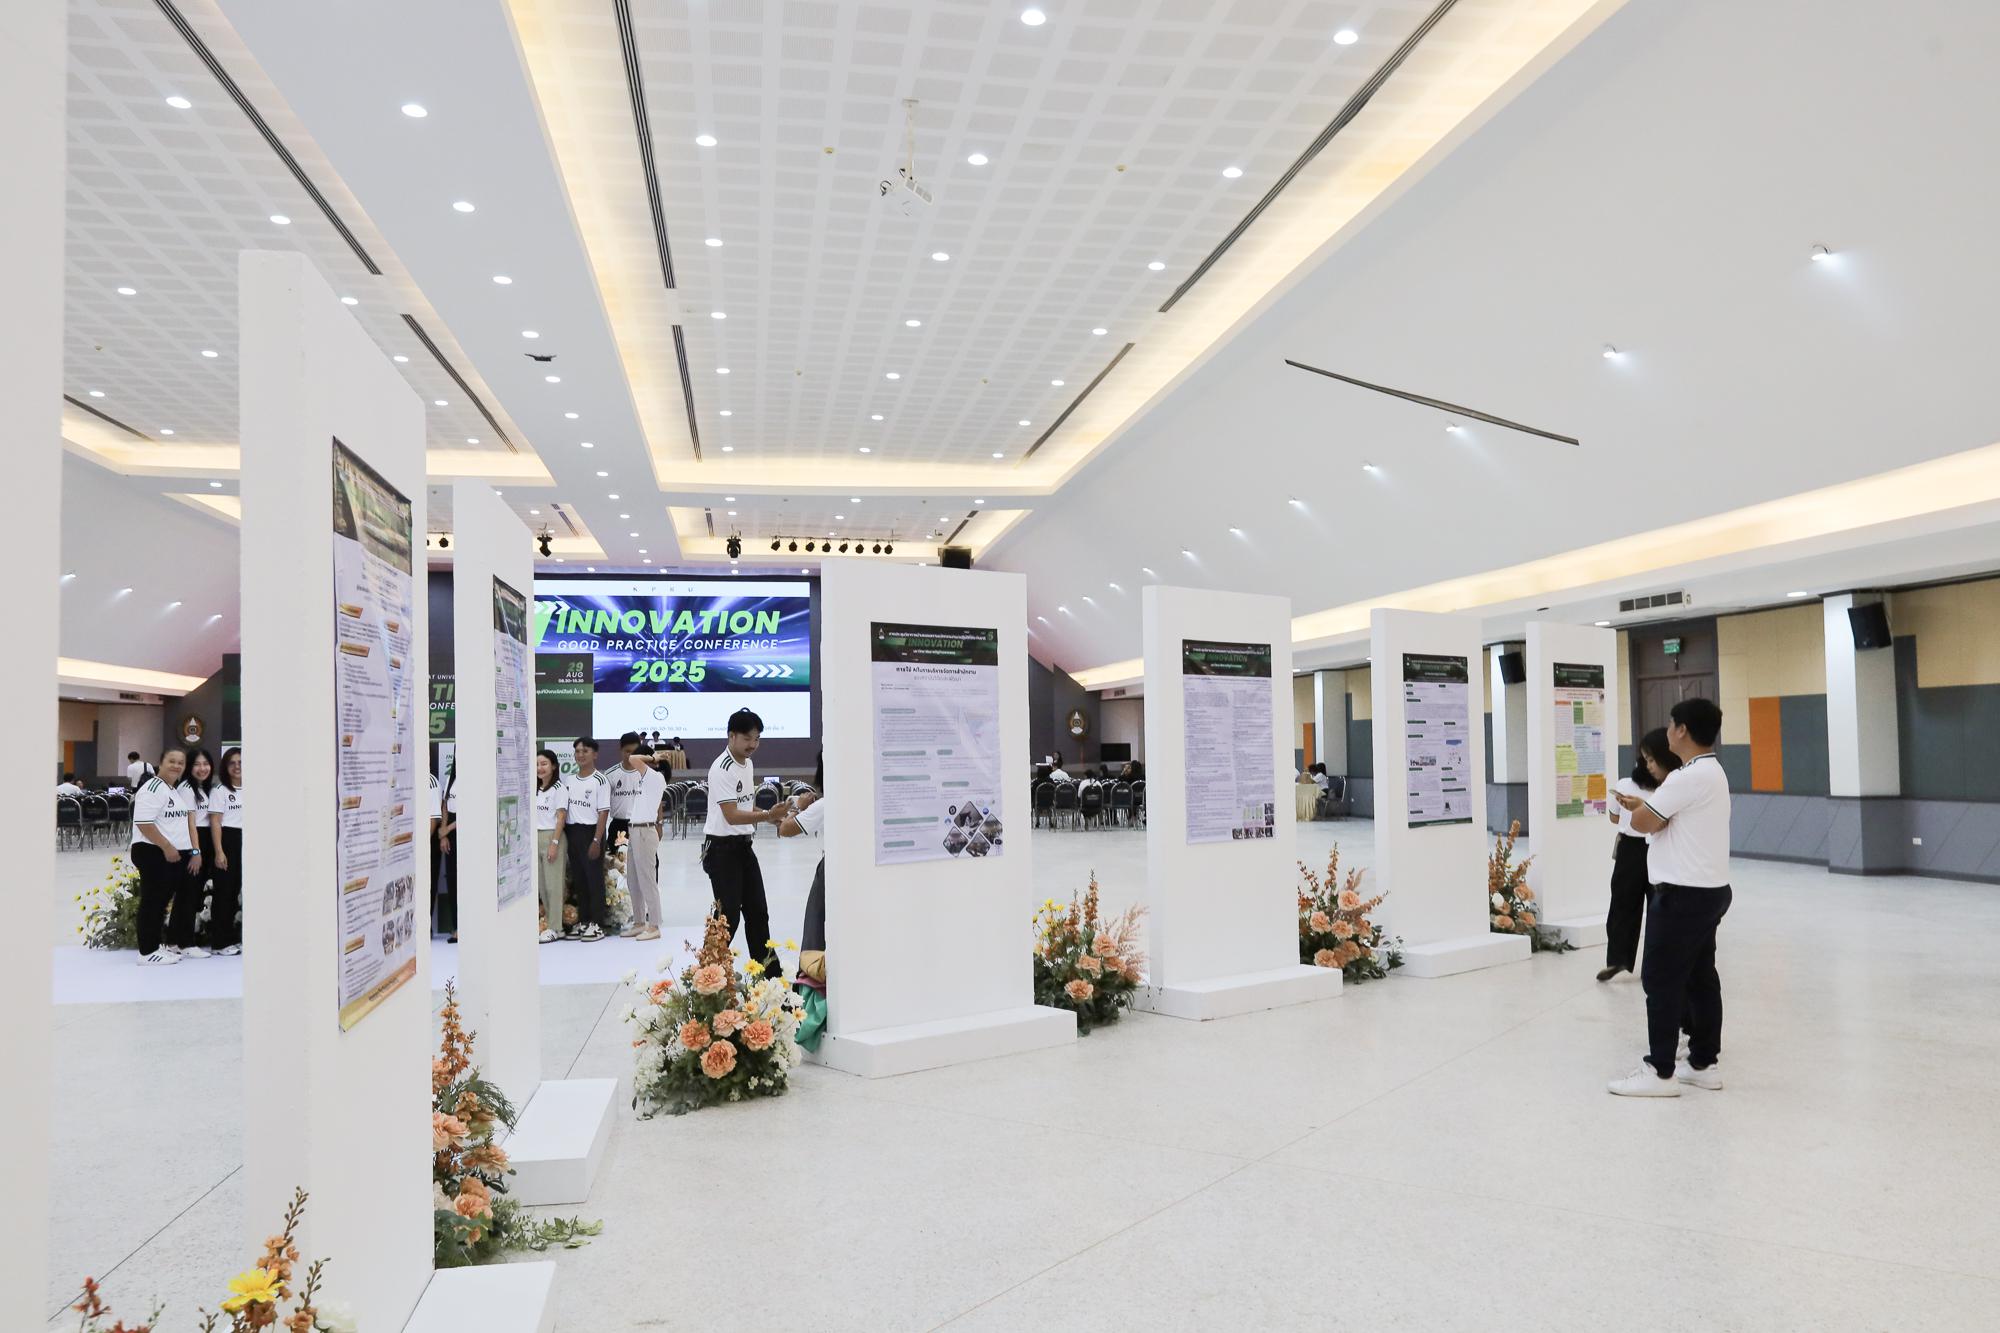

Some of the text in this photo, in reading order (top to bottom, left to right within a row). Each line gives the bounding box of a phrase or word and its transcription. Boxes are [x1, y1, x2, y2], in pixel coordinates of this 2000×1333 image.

[556, 609, 780, 634] INNOVATION
[557, 639, 778, 650] GOOD PRACTICE CONFERENCE
[567, 661, 584, 672] 29
[629, 660, 707, 683] 2025
